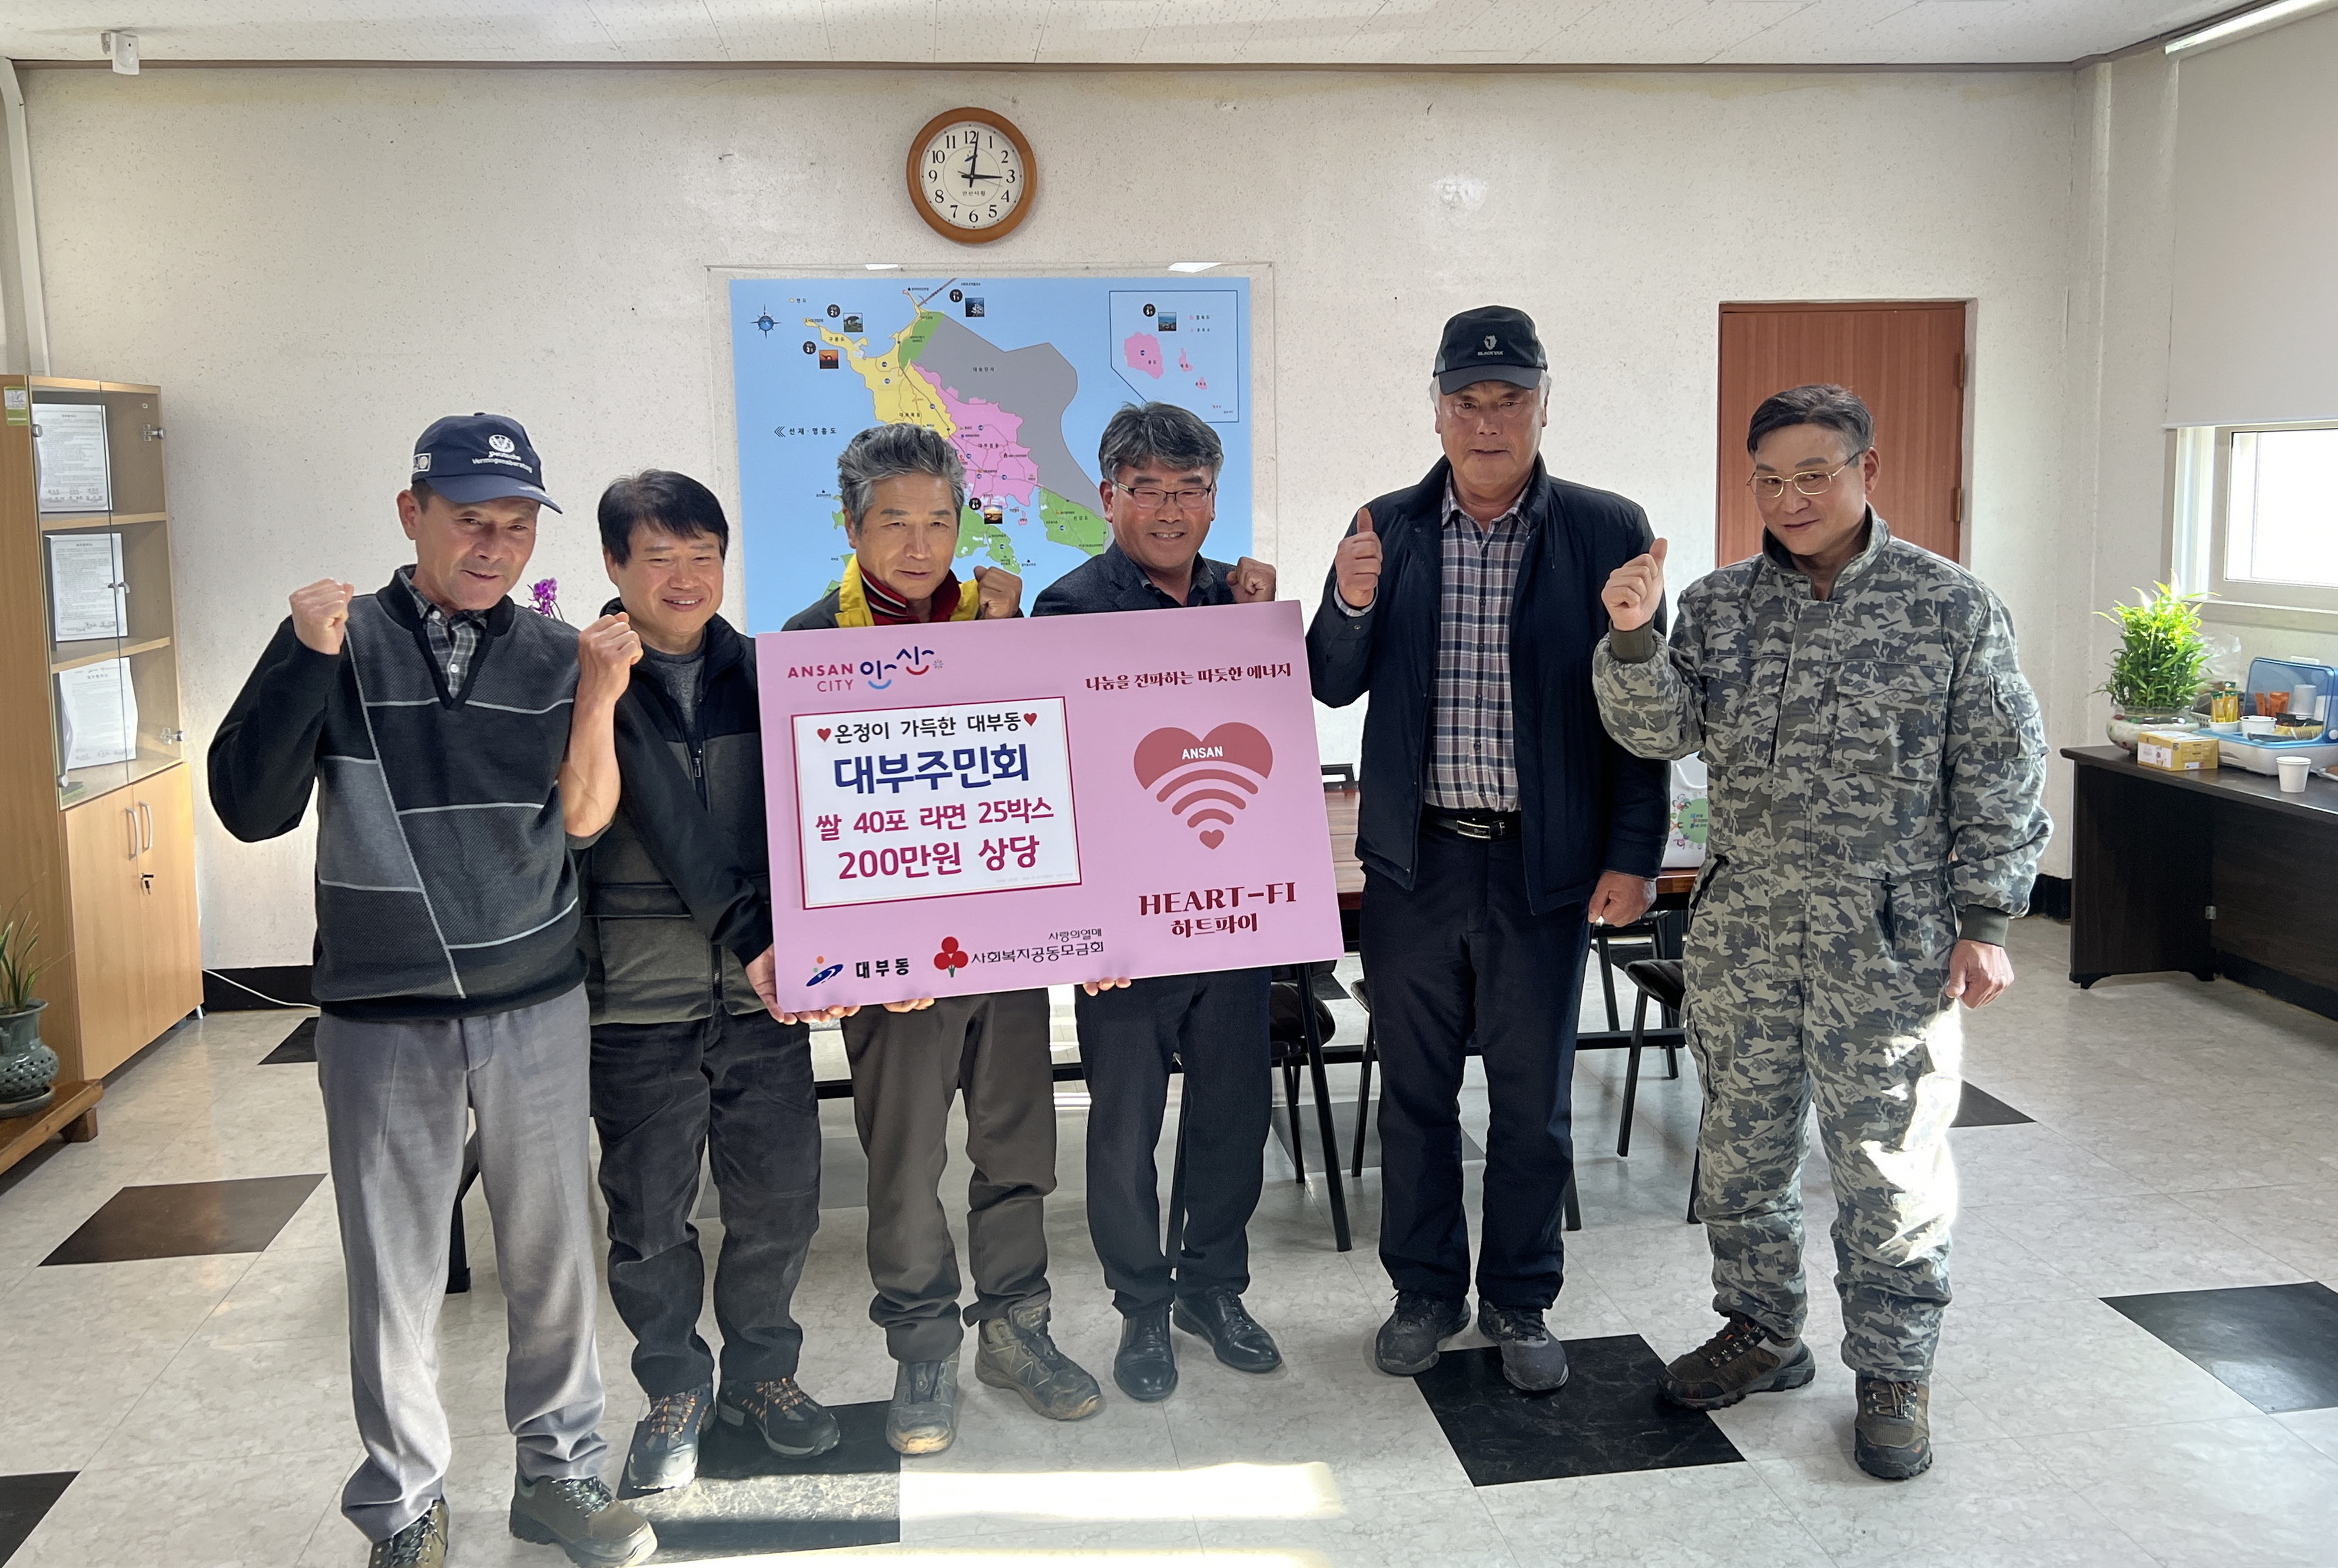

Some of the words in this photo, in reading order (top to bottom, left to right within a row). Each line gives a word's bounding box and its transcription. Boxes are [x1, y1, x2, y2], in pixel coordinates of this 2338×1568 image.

[946, 135, 956, 148] 11
[964, 131, 977, 144] 12
[989, 136, 993, 148] 1
[932, 150, 945, 164] 10
[1001, 150, 1009, 164] 2
[928, 170, 937, 183] 9
[1006, 170, 1015, 184] 3
[935, 190, 944, 203] 8
[1001, 190, 1010, 202] 4
[950, 205, 958, 218] 7
[969, 210, 979, 222] 6
[989, 205, 997, 218] 5
[788, 663, 854, 678] ANSAN
[1086, 675, 1130, 691] 나눔을
[1133, 671, 1194, 688] 전파하는
[1197, 666, 1243, 683] 따듯한
[1246, 662, 1291, 679] 에너지
[817, 679, 854, 692] CITY
[834, 722, 890, 744] 온정이
[901, 716, 956, 738] 가득한
[967, 712, 1021, 732] 대부동
[1182, 746, 1223, 760] ANSAN
[834, 743, 1029, 794] 대부주민회
[815, 814, 842, 841] 쌀
[853, 809, 908, 834] 40포
[920, 803, 967, 830] 라면
[978, 797, 1054, 824] 25박스
[838, 842, 962, 879] 200만원
[979, 835, 1040, 871] 상당
[1139, 882, 1296, 916] HEART-FI
[1170, 913, 1258, 938] 하트파이
[1048, 928, 1102, 943] 사랑의열매
[971, 941, 1105, 964] 사회복지공동모금회
[855, 957, 910, 979] 대부동
